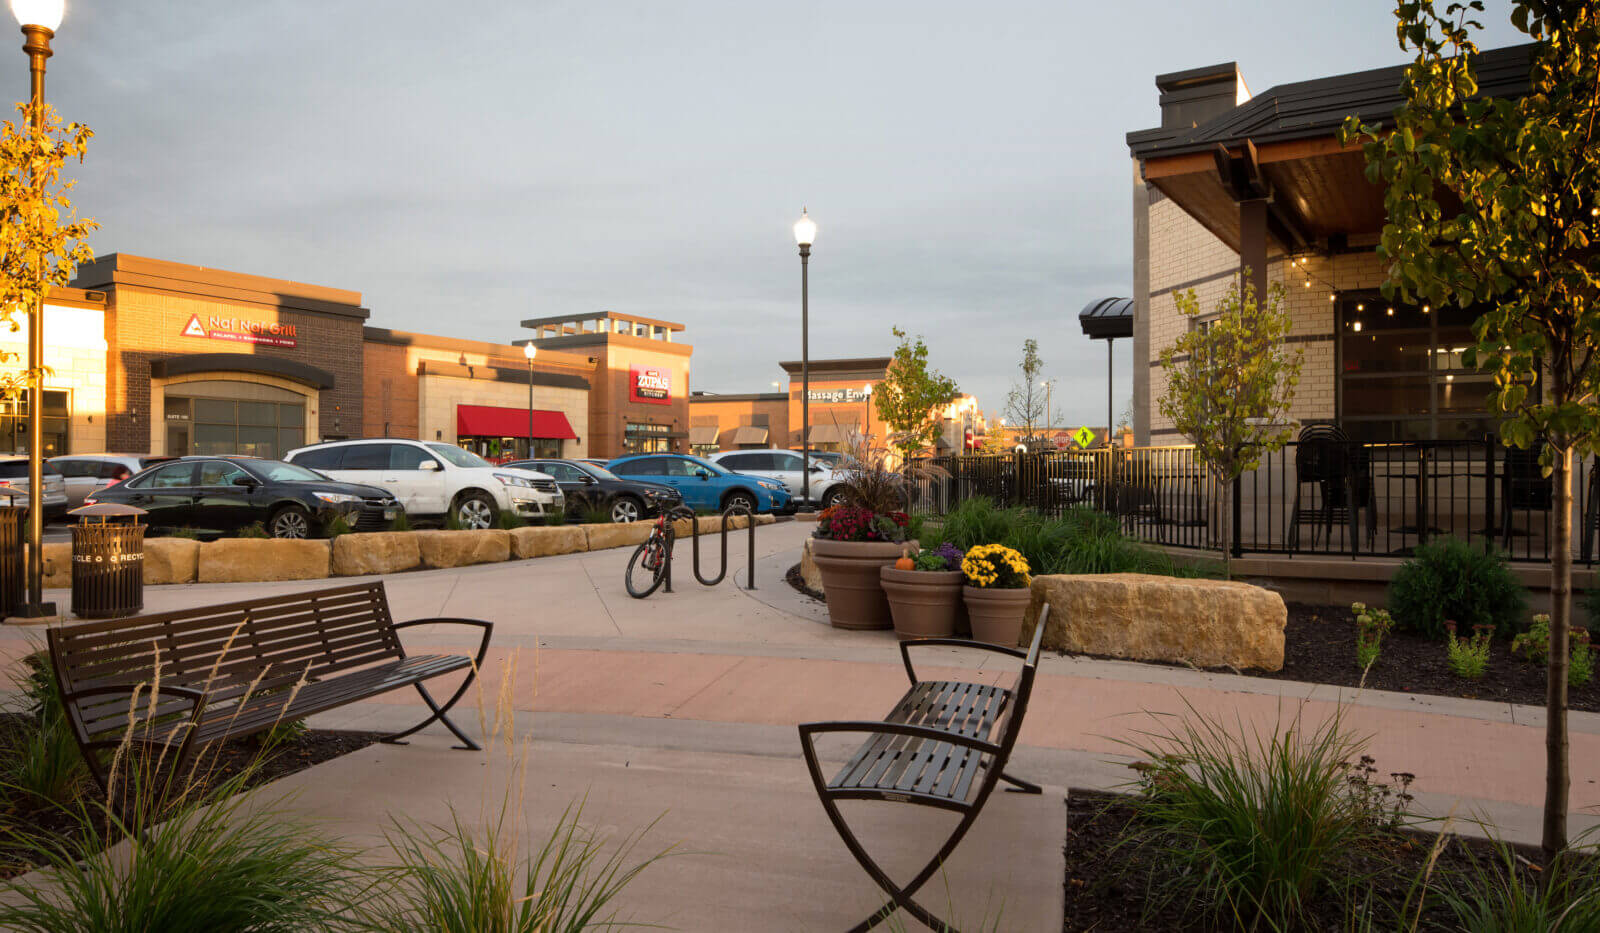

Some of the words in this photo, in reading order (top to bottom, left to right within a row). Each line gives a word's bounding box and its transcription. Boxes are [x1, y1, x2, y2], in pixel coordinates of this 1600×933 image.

[209, 315, 237, 331] Naf
[240, 319, 266, 334] Naf
[269, 323, 296, 337] Grill
[638, 375, 668, 389] ZUPAS
